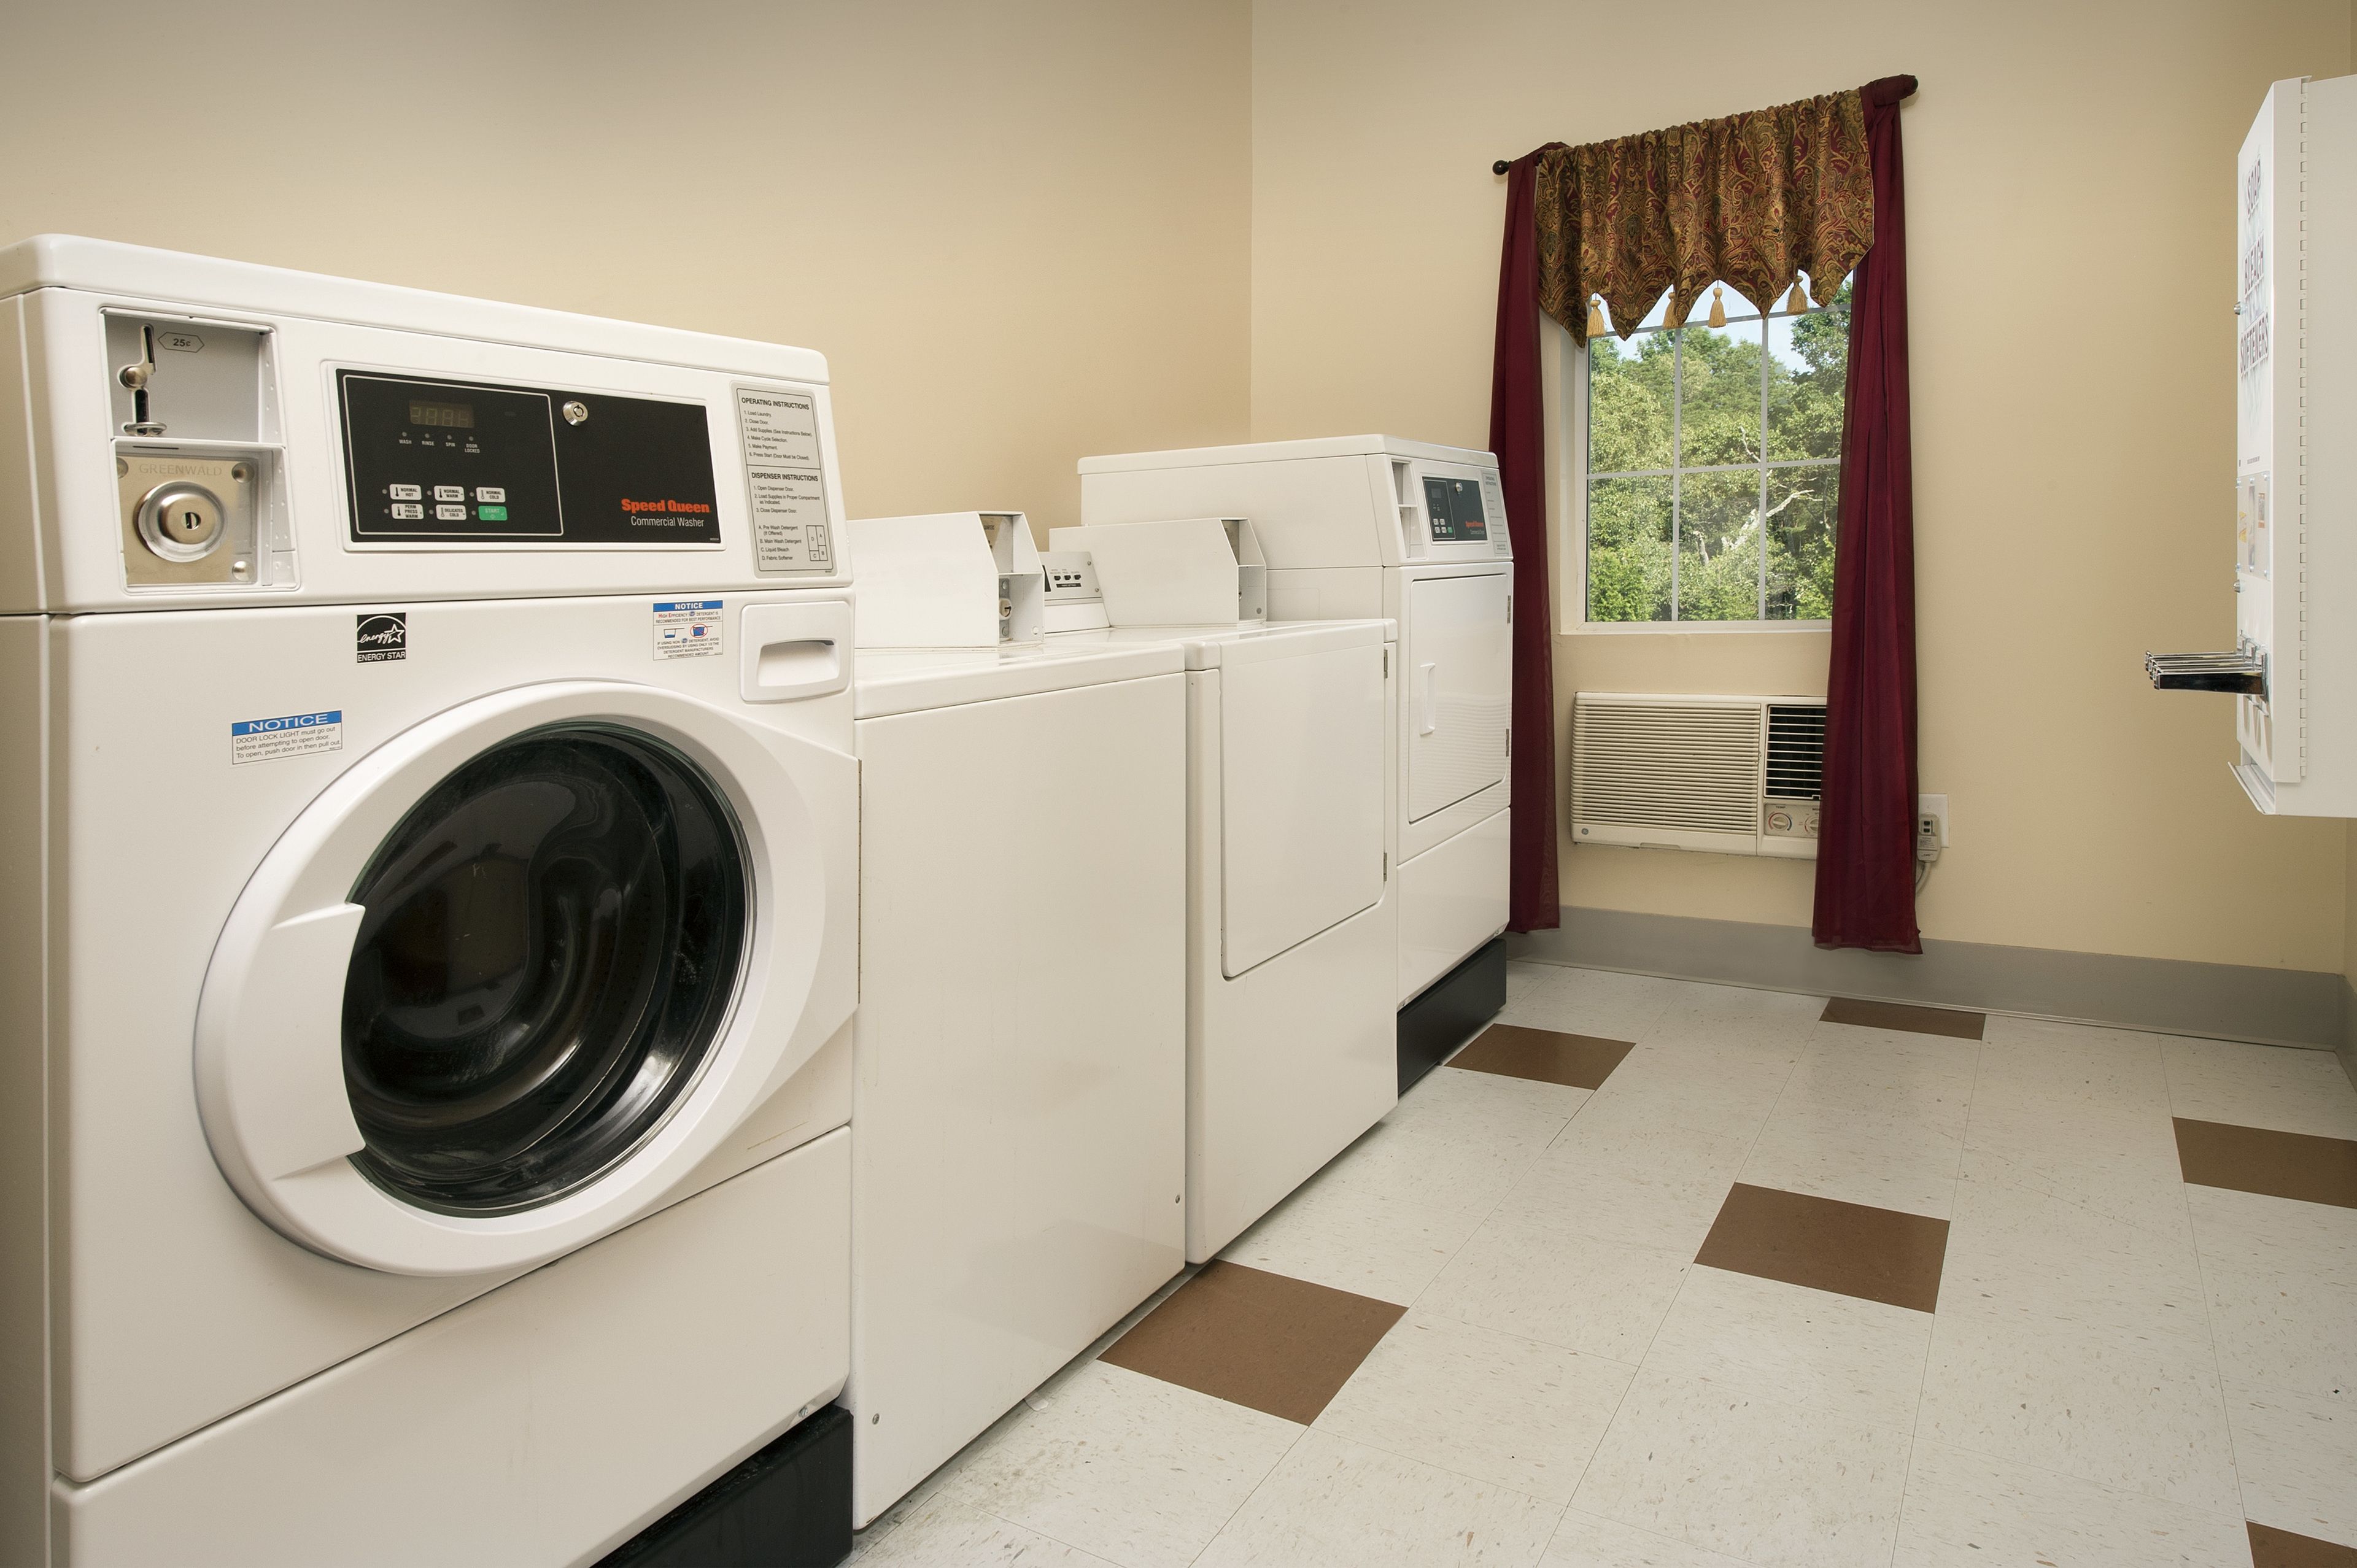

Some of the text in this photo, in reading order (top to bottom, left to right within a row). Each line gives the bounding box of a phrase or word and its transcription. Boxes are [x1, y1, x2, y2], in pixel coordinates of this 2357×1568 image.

[2247, 158, 2261, 218] SOAP
[2244, 232, 2264, 298] BLEACH
[2240, 312, 2269, 377] SOFTENERS
[773, 401, 809, 410] INSTRUCTIONS
[138, 463, 222, 476] GREENWALD
[621, 498, 711, 514] Speed Queen
[631, 516, 704, 527] Commercial Washer
[360, 633, 390, 644] energy
[358, 653, 385, 662] ENERGY
[249, 713, 328, 732] NOTICE
[258, 739, 290, 748] attempting
